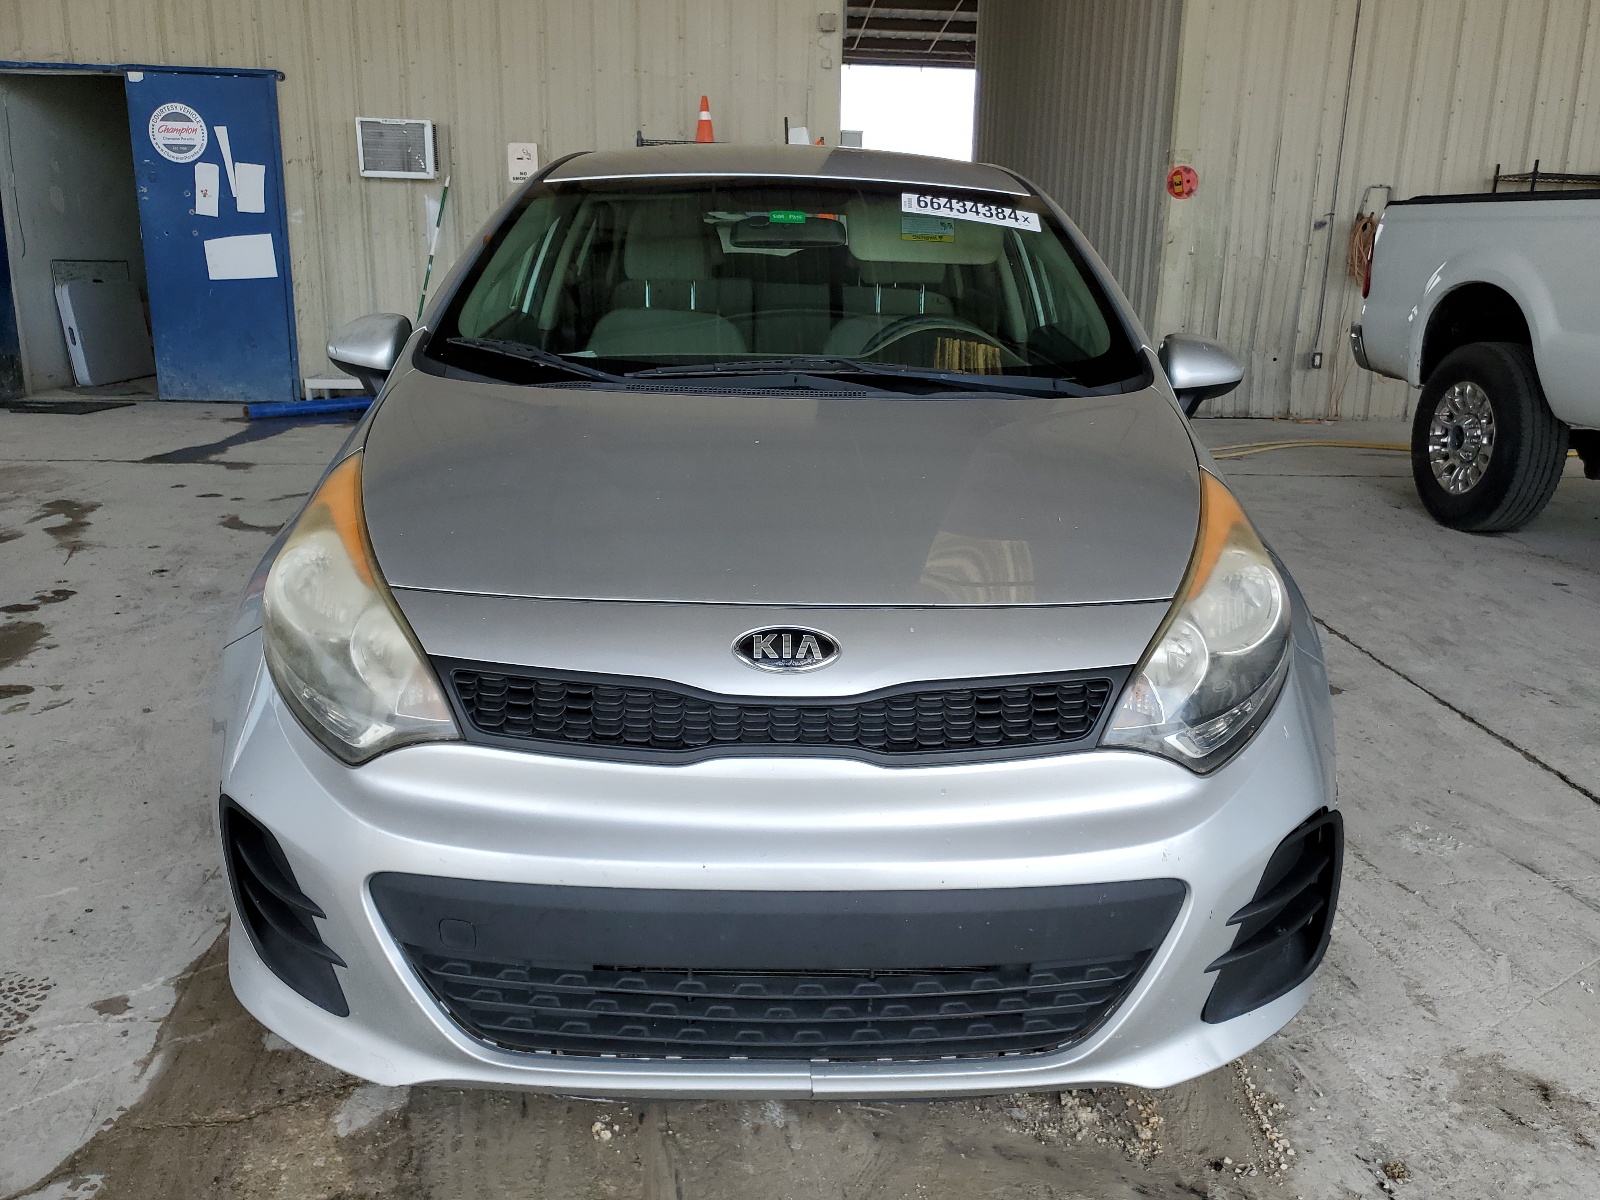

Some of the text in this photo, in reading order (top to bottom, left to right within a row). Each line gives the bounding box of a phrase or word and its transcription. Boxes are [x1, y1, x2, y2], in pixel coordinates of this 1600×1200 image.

[152, 104, 202, 125] COURTESY VEHICLE
[157, 124, 198, 136] Champion
[916, 195, 1019, 222] 66434384
[752, 633, 823, 660] KIA
